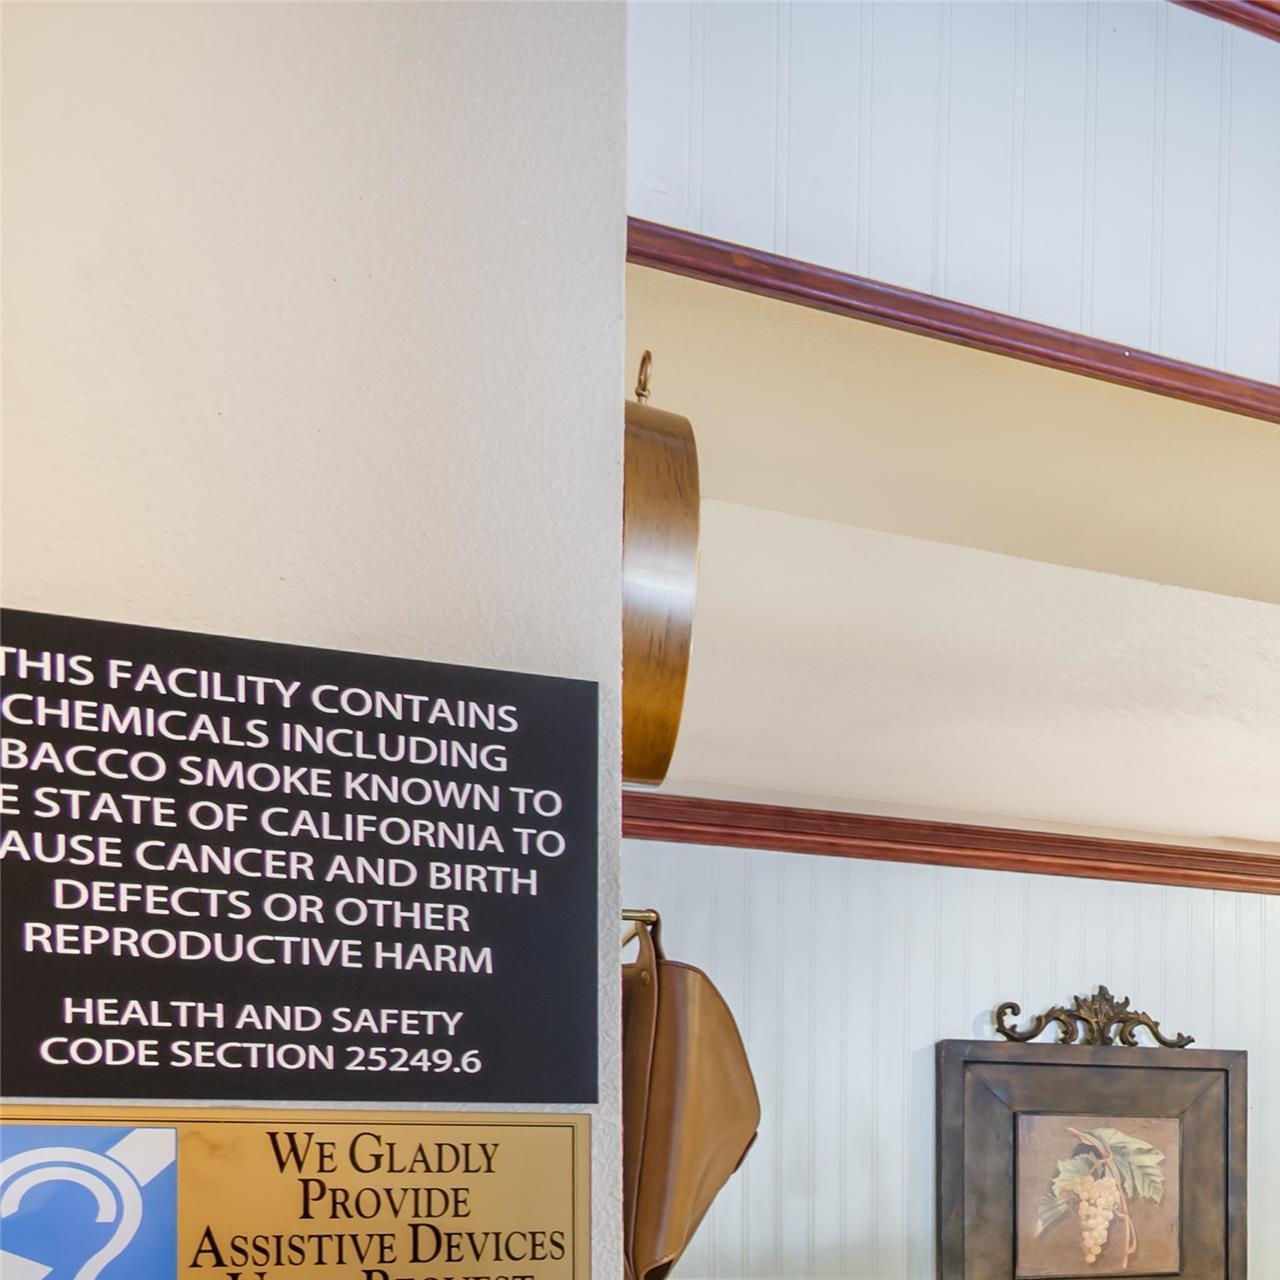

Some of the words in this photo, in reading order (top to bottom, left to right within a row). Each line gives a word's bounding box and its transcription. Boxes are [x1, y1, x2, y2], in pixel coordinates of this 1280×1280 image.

[0, 646, 94, 685] THIS
[109, 660, 300, 707] FACILITY
[312, 685, 518, 732] CONTAINS
[2, 694, 268, 748] CHEMICALS
[283, 723, 507, 771] INCLUDING
[0, 738, 166, 781] BACCO
[179, 756, 332, 797] SMOKE
[346, 772, 499, 811] KNOWN
[510, 787, 562, 816] TO
[34, 787, 177, 827] STATE
[189, 801, 248, 831] OF
[261, 808, 504, 852] CALIFORNIA
[513, 828, 565, 857] TO
[0, 830, 122, 867] AUSE
[136, 841, 314, 880] CANCER
[325, 855, 417, 886] AND
[430, 862, 536, 895] BIRTH
[55, 879, 251, 919] DEFECTS
[264, 893, 324, 923] OR
[336, 898, 469, 931] OTHER
[25, 923, 362, 967] REPRODUCTIVE
[376, 942, 492, 973] HARM
[65, 998, 223, 1028] HEALTH
[236, 1005, 321, 1031] AND
[332, 1008, 463, 1035] SAFETY
[40, 1037, 159, 1066] CODE
[171, 1041, 333, 1069] SECTION
[346, 1047, 481, 1073] 25249.6
[265, 1132, 336, 1173] WE
[349, 1132, 500, 1173] GLADLY
[298, 1178, 471, 1219] PROVIDE
[189, 1225, 396, 1267] ASSISTIVE
[408, 1223, 565, 1263] DEVICES
